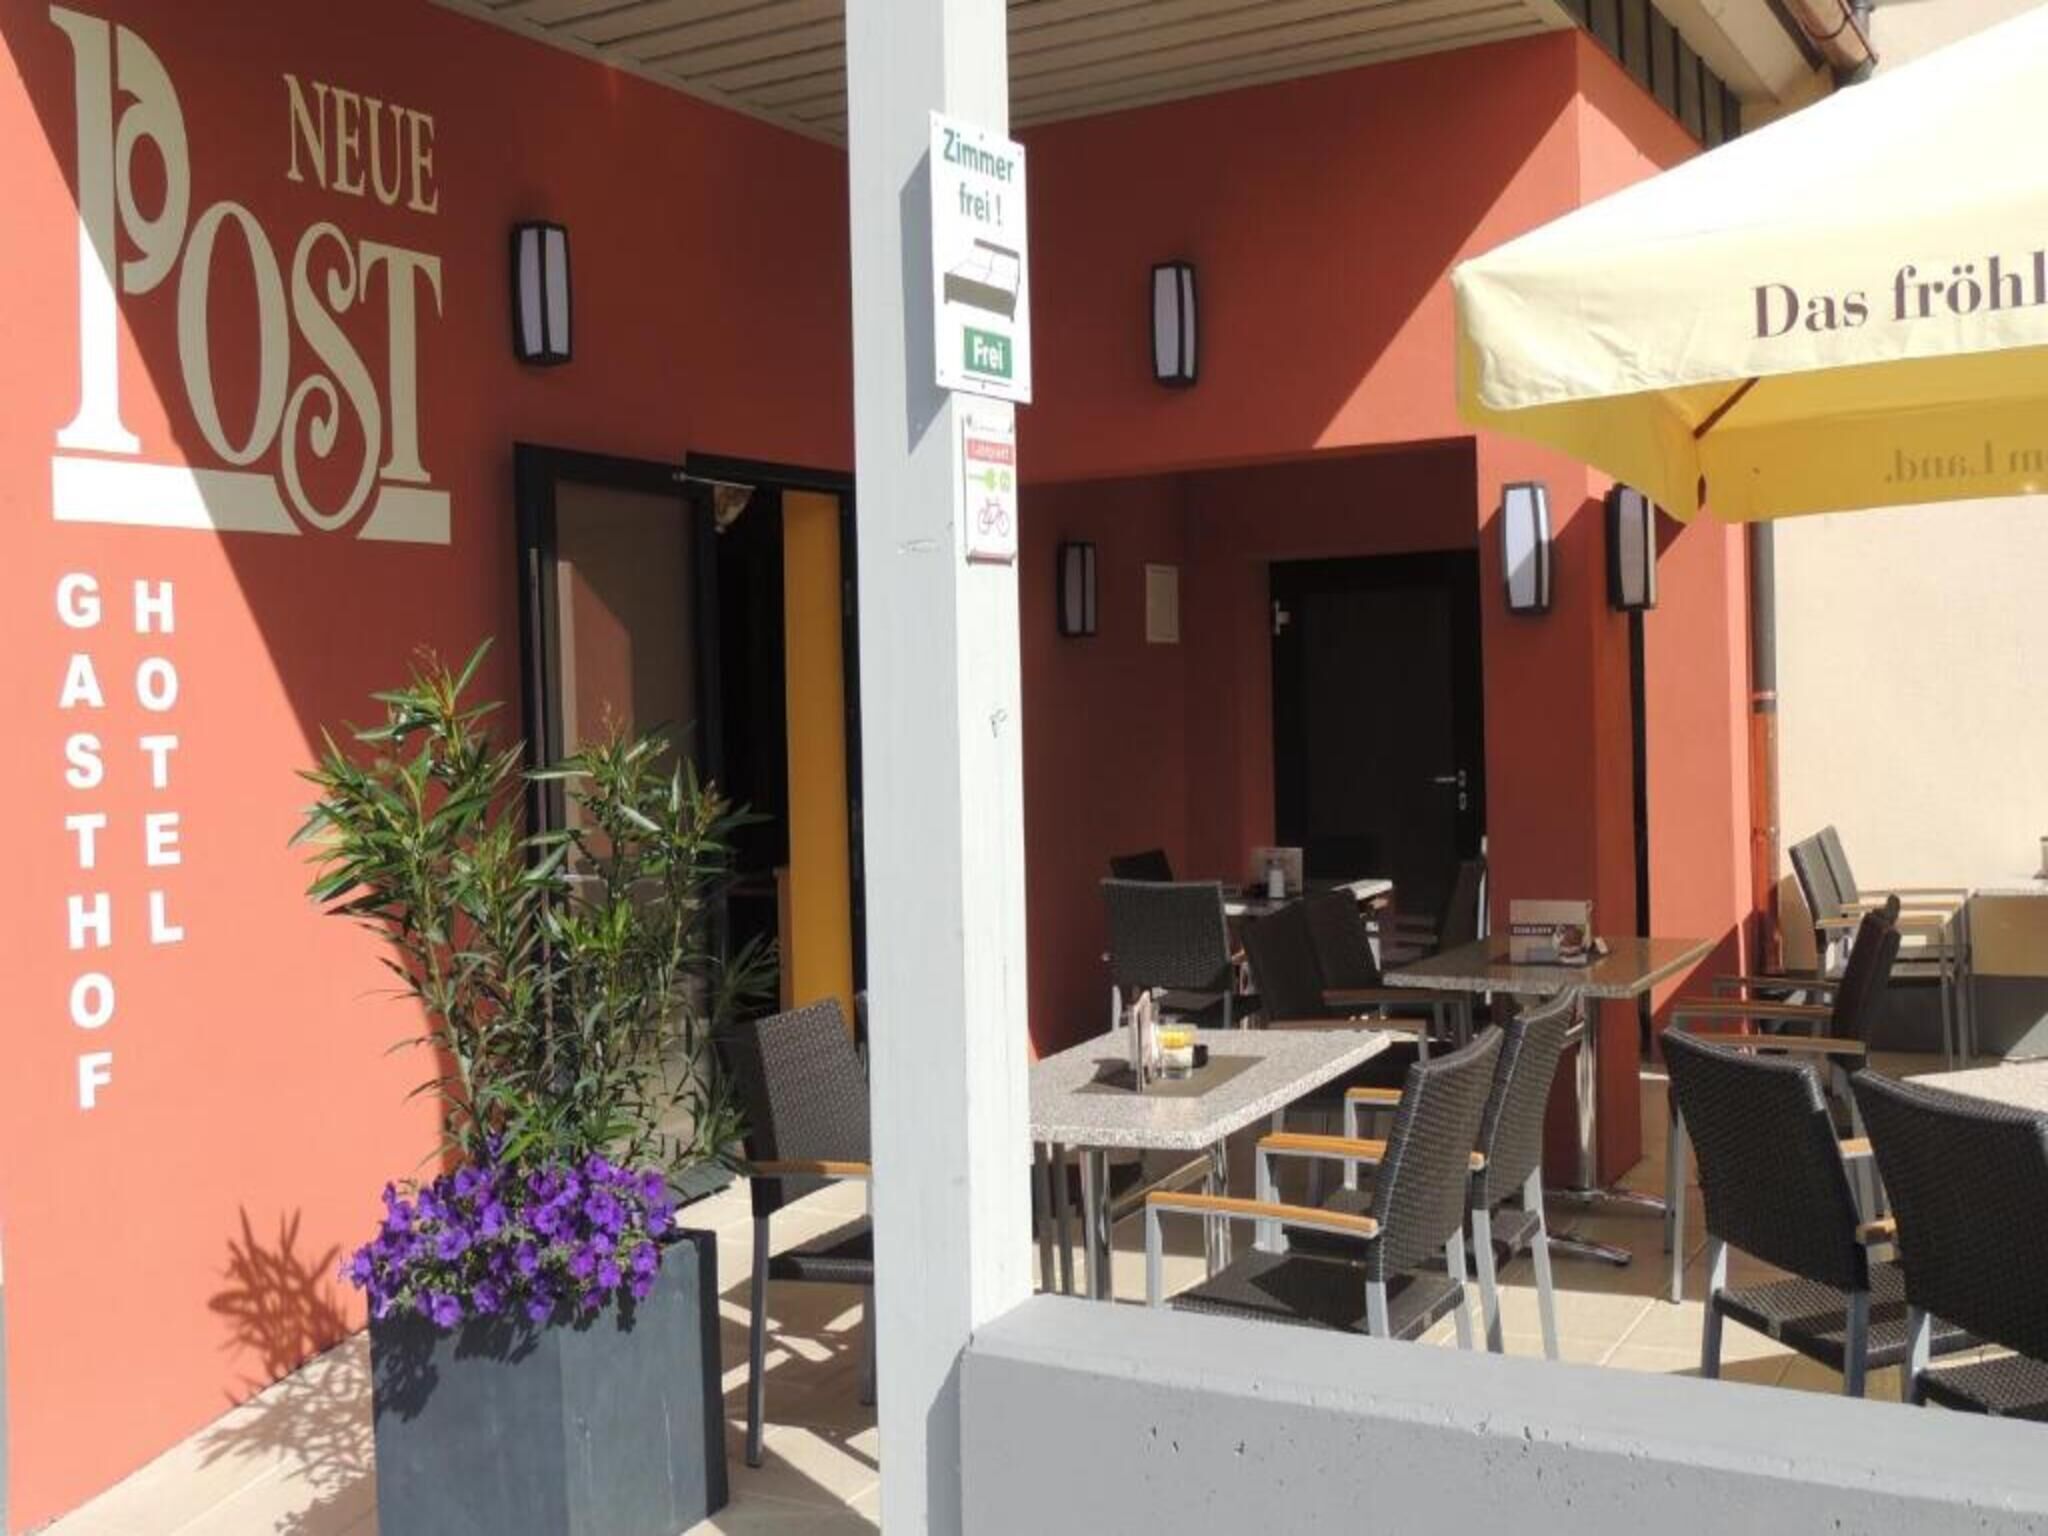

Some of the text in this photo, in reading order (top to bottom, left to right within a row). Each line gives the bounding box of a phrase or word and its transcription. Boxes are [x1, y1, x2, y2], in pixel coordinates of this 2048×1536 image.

[283, 73, 439, 214] NEUE
[943, 127, 1014, 184] Zimmer
[49, 4, 443, 531] POST
[1752, 248, 2048, 339] Das fröhl
[973, 333, 1004, 371] Frei
[134, 579, 183, 944] HOTEL
[56, 573, 115, 1109] GASTHOF
